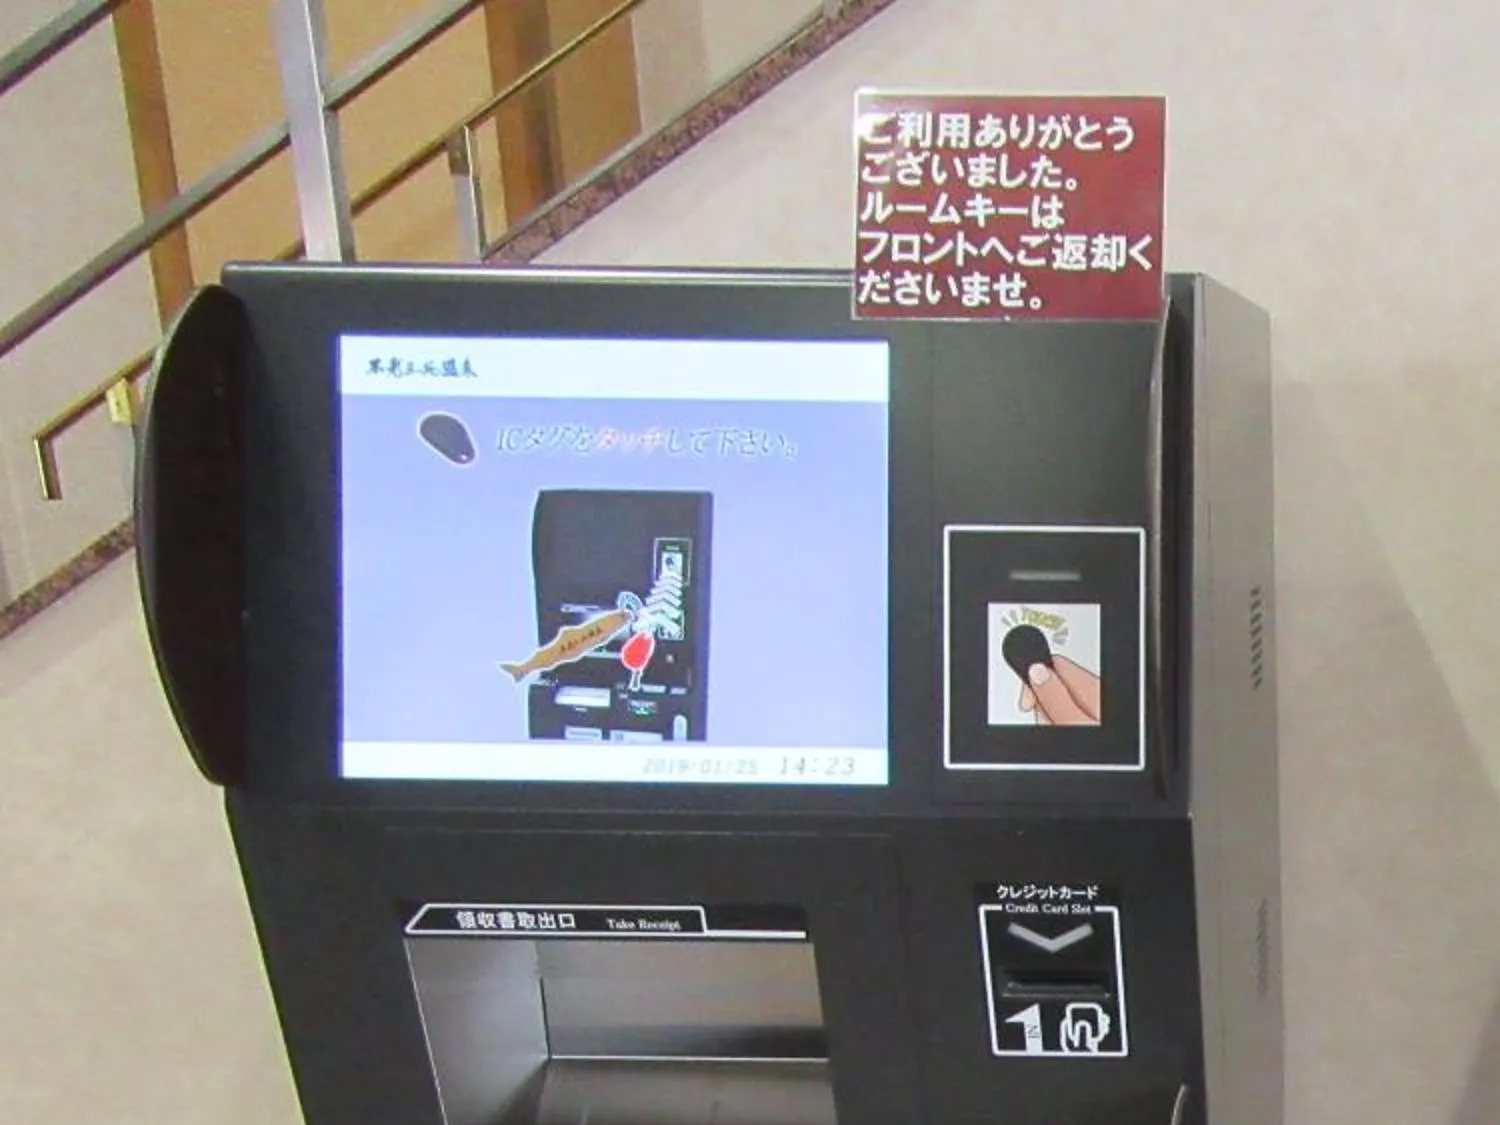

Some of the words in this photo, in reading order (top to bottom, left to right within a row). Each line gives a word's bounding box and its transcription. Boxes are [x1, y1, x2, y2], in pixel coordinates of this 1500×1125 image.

[859, 110, 1135, 151] ご利用ありがとう
[861, 151, 1078, 191] ございました。
[860, 191, 1065, 229] ルームキーは
[859, 231, 1152, 271] フロントへご返却く
[858, 270, 1043, 310] ださいませ。
[780, 755, 857, 776] 14:23
[997, 884, 1100, 900] クレジットカード
[455, 911, 576, 929] 領収書取出口
[1004, 903, 1039, 914] Credit
[1041, 904, 1069, 914] Card
[606, 917, 636, 930] Take
[638, 918, 682, 932] Receipt
